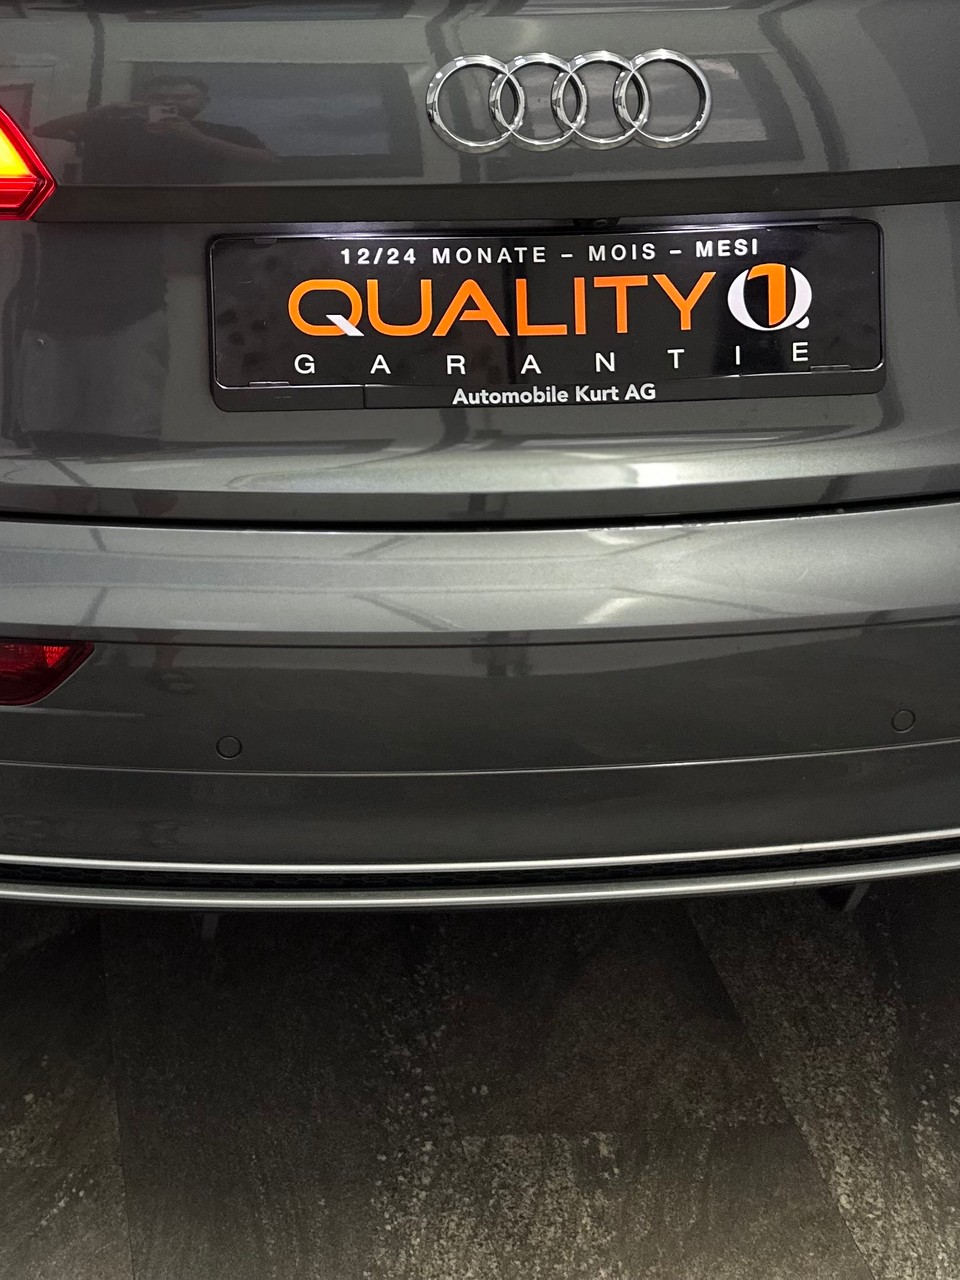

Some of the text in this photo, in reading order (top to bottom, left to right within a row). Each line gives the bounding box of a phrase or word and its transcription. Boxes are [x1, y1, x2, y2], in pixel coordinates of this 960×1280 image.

[340, 247, 417, 265] 12/24
[432, 246, 547, 265] MONATE
[588, 242, 657, 262] MOIS
[695, 237, 758, 259] MESI
[287, 271, 717, 337] QUALITY
[293, 341, 810, 376] GARANTIE
[452, 383, 656, 405] Automobile Kurt AG
